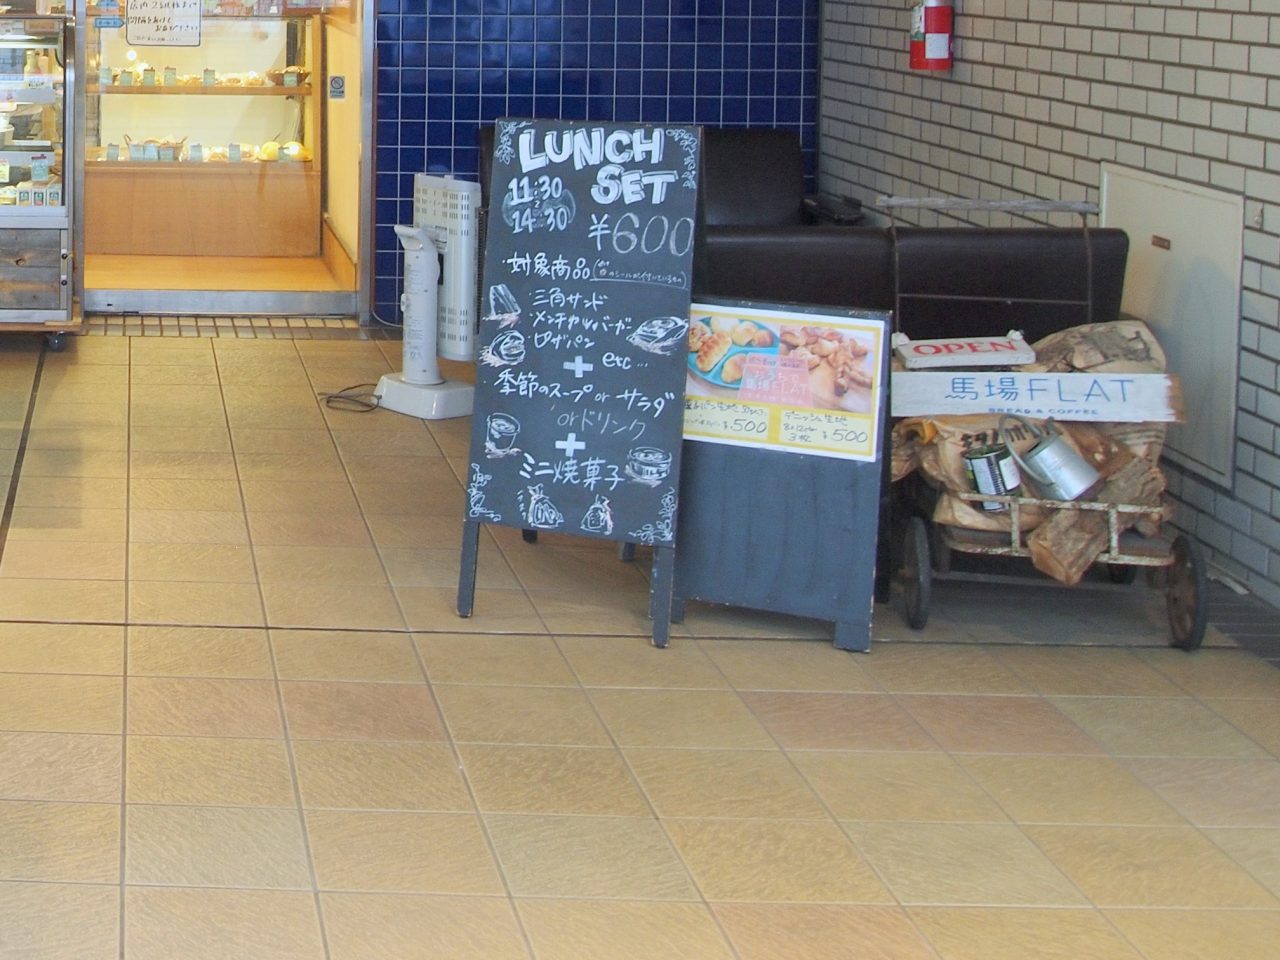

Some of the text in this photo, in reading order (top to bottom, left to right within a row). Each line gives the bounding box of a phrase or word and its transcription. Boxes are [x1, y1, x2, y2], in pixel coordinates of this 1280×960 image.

[518, 127, 665, 173] LUNCH
[507, 176, 563, 206] 11:30
[590, 165, 679, 205] SET
[511, 208, 569, 235] 14:30
[588, 212, 695, 257] ¥600
[911, 340, 1018, 357] OPEN
[494, 368, 594, 403] 季節のスープ
[616, 388, 676, 419] サラダ
[945, 376, 1135, 403] 馬場FLAT
[1048, 407, 1099, 416] COFFEE
[519, 452, 625, 491] ミニ焼菓子
